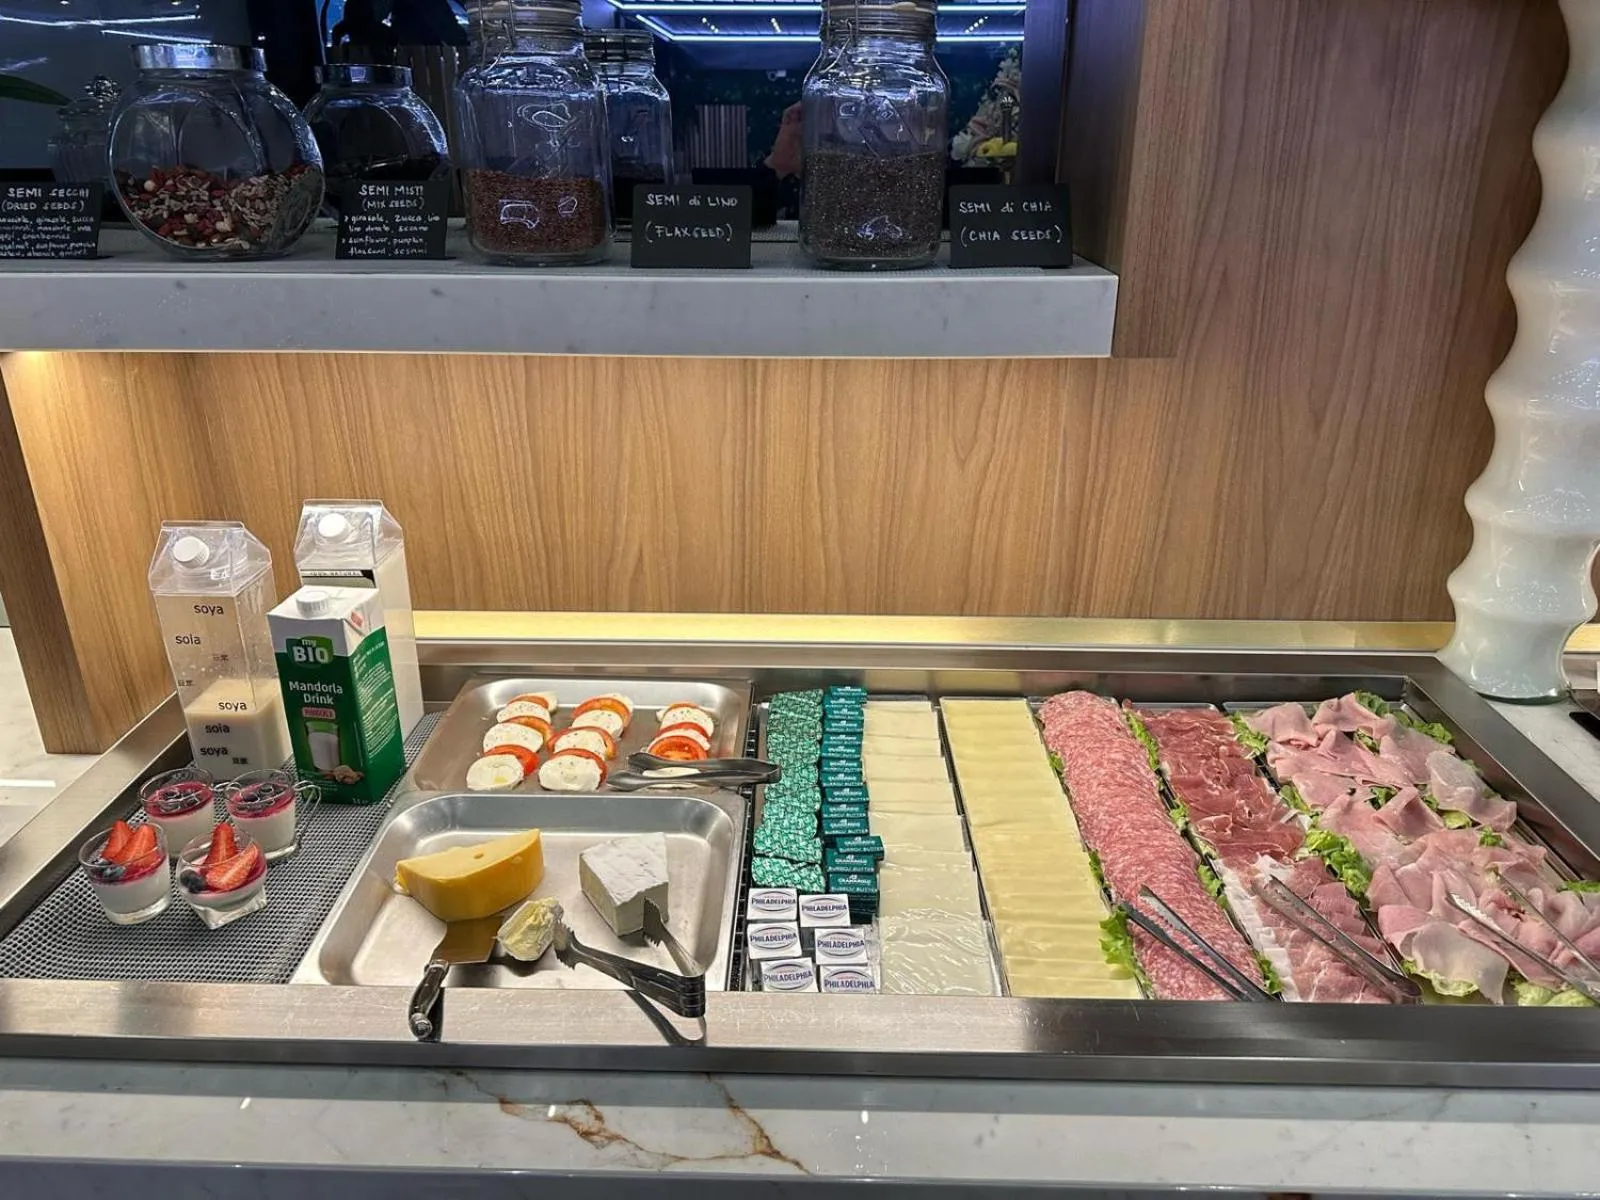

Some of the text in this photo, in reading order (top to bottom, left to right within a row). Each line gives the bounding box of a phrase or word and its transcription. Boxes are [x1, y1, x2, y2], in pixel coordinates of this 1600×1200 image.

[7, 187, 42, 198] SEMI
[358, 184, 389, 196] SEMI
[646, 193, 680, 206] SEMI
[688, 195, 701, 206] di
[959, 201, 1053, 214] SEMI di CHIA
[961, 224, 1062, 248] (CHIA SEEDS)
[194, 604, 224, 616] soya
[175, 634, 202, 645] soia
[302, 638, 317, 648] my
[292, 646, 329, 664] BIO
[288, 681, 344, 695] Mandorla
[303, 693, 335, 706] Drink
[218, 701, 247, 713] soya
[205, 723, 231, 734] soia
[200, 746, 229, 757] soya
[751, 897, 796, 906] PHILADELPHIA
[801, 904, 848, 912] PHILADELPHIA
[749, 932, 797, 942] PHILADELPHIA
[817, 940, 865, 949] PHILADELPHIA
[763, 970, 813, 982] PHILADELPHIA
[824, 980, 876, 989] PHILADELPHIA
